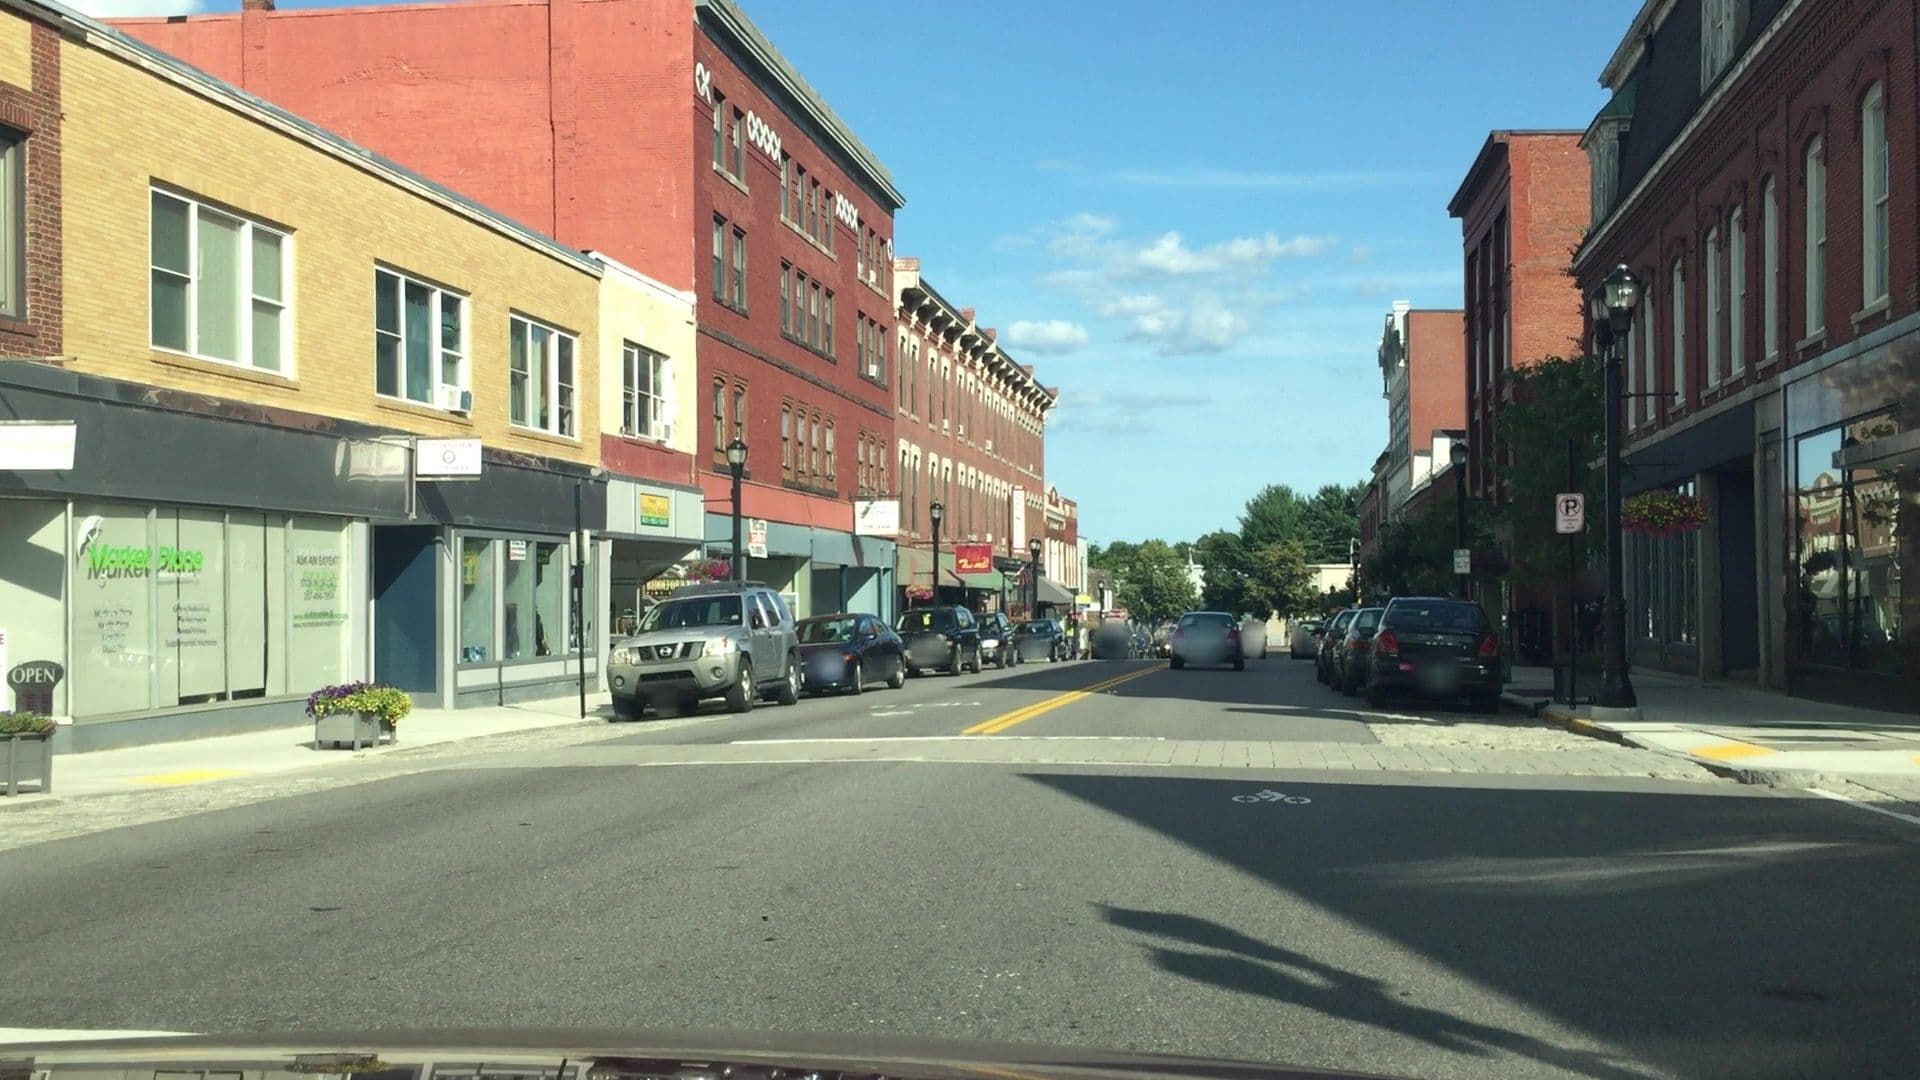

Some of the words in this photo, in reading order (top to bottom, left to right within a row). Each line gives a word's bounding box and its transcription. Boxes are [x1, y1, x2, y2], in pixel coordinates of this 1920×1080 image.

[87, 544, 152, 569] Market
[158, 546, 203, 571] Place
[12, 667, 55, 683] OPEN
